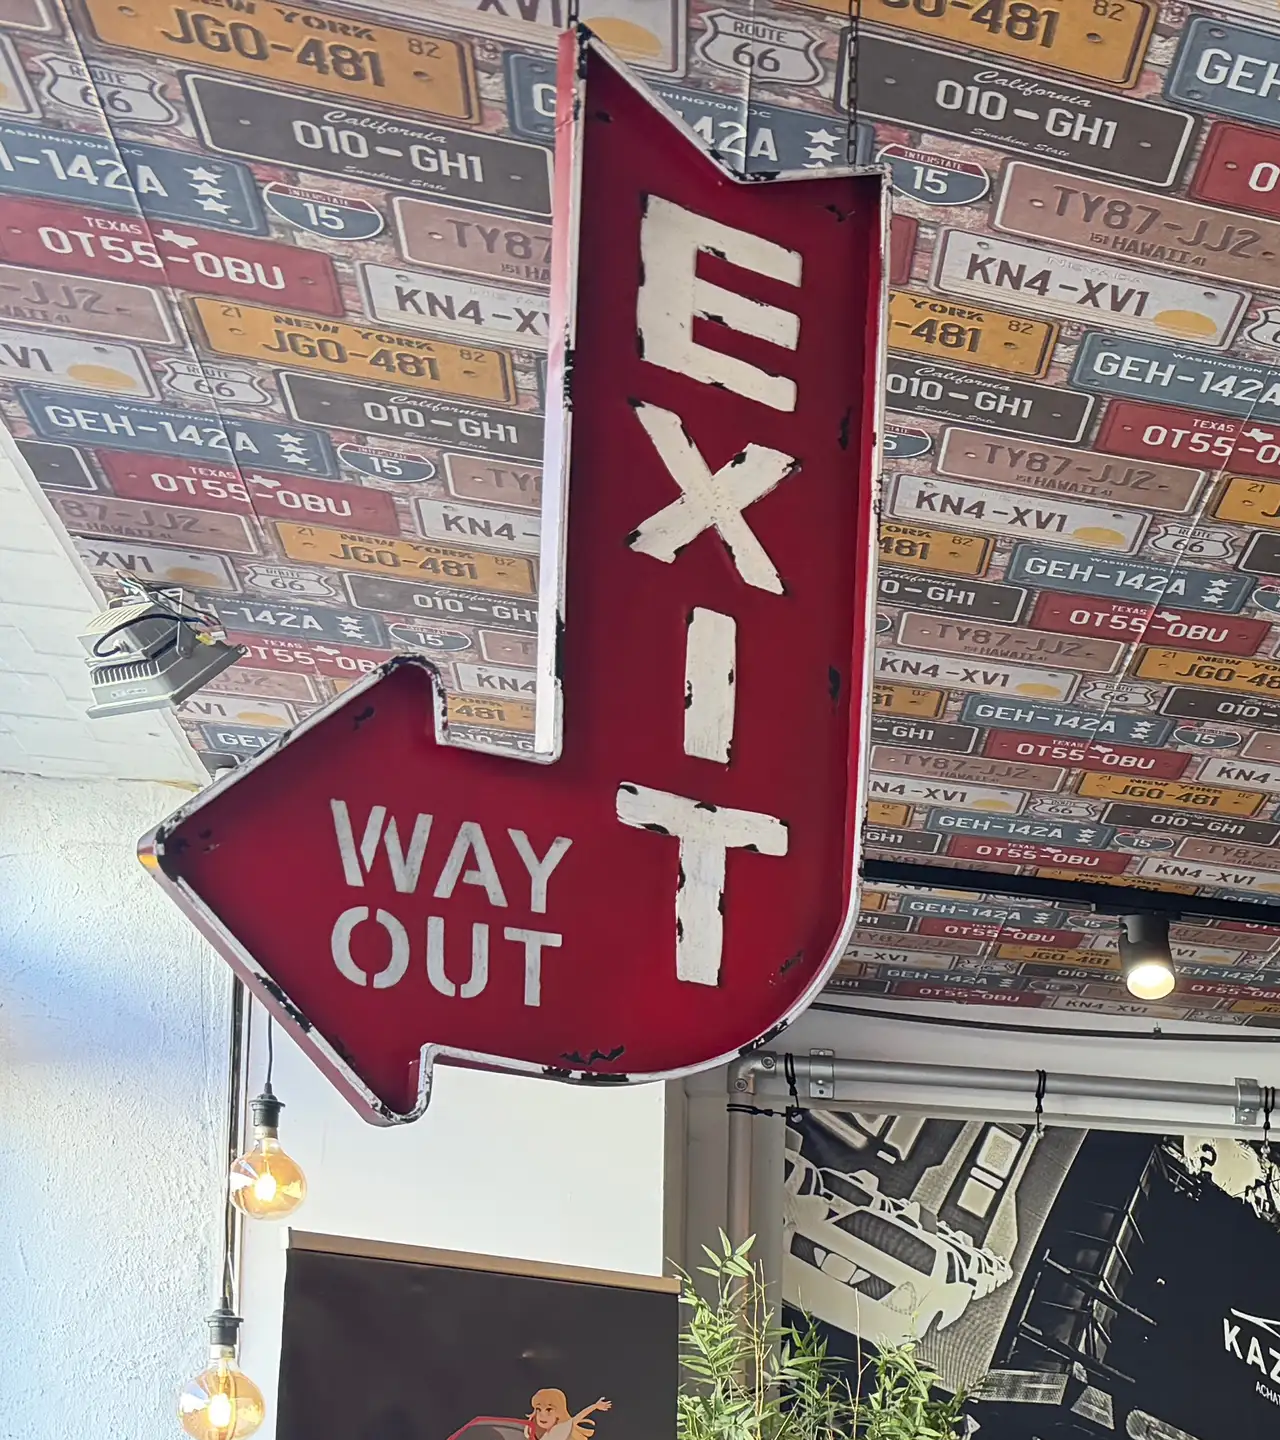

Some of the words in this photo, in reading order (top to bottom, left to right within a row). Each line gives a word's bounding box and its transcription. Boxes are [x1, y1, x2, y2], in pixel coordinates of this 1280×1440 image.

[407, 38, 441, 59] 82
[68, 63, 129, 85] ROUTE
[973, 70, 1093, 109] California
[79, 86, 134, 115] 66
[323, 110, 448, 144] California
[899, 148, 965, 171] INTERSTATE
[913, 165, 949, 195] 15
[83, 216, 142, 235] TEXAS
[300, 205, 345, 231] 15
[1053, 184, 1263, 259] TY87-JJ2
[966, 253, 1150, 316] KN4-XV1
[273, 315, 340, 334] NEW
[355, 327, 436, 353] YORK
[45, 405, 259, 455] GEH-142A
[616, 195, 802, 987] EXIT
[975, 703, 1117, 735] GEH-142A
[330, 799, 573, 914] WAY
[330, 906, 563, 1008] OUT
